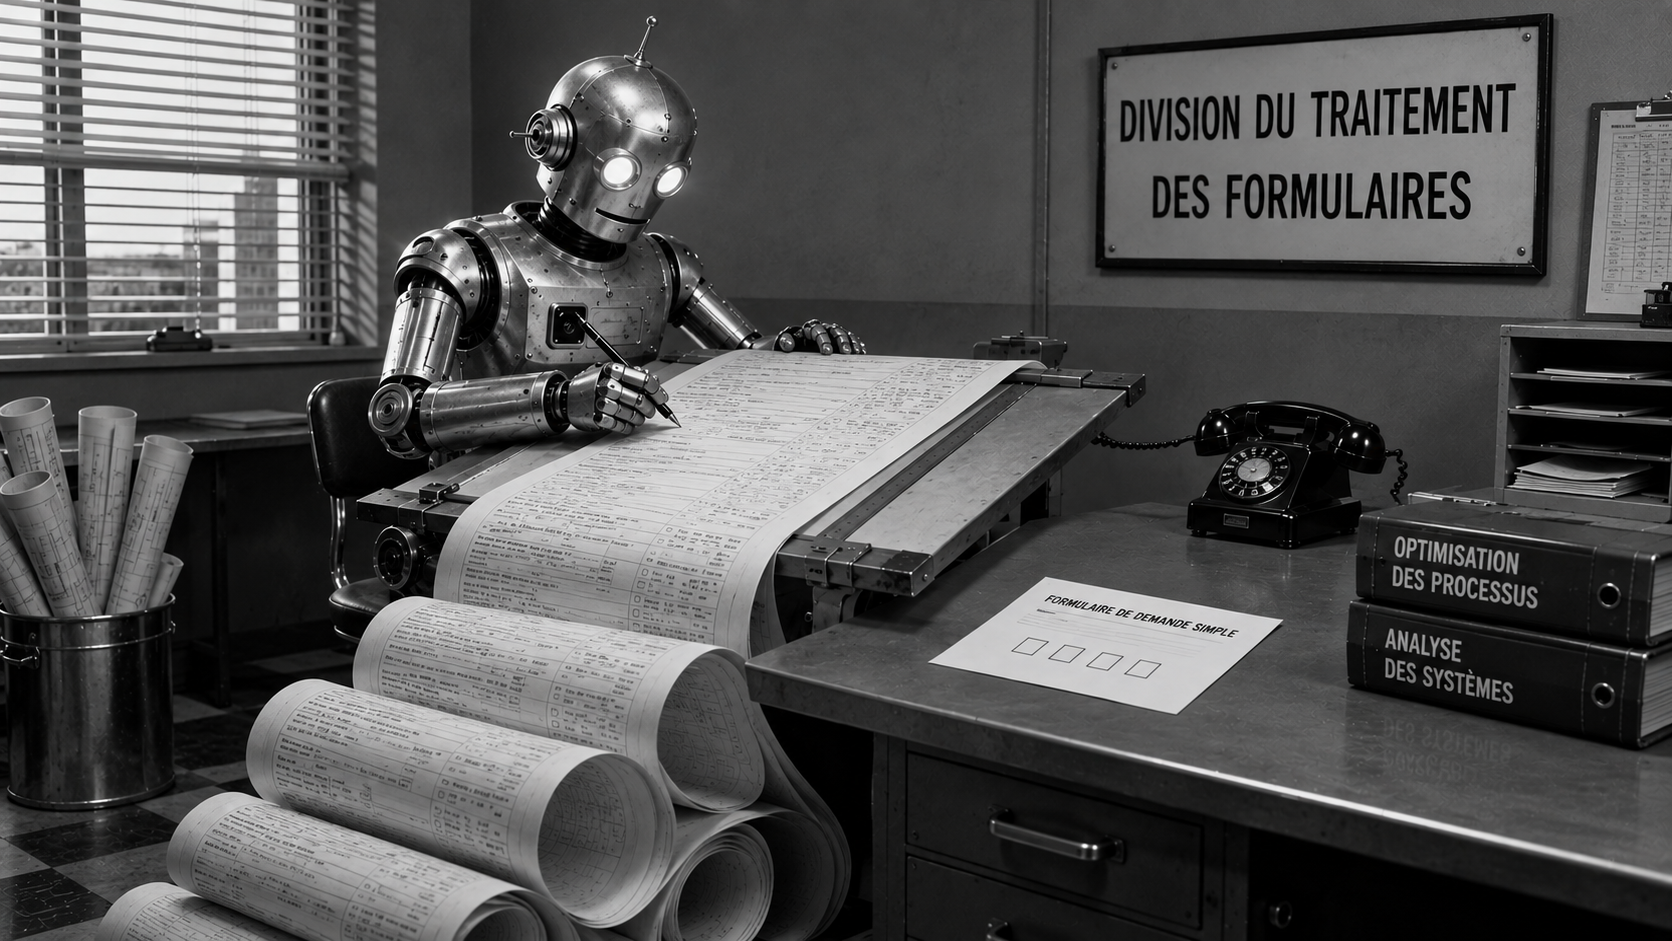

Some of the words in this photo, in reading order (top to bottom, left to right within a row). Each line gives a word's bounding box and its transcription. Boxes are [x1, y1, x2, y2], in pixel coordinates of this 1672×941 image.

[1120, 95, 1241, 142] DIVISION
[1255, 92, 1296, 139] DU
[1311, 83, 1516, 137] TRAITEMENT
[1153, 174, 1210, 218] DES
[1226, 171, 1472, 220] FORMULAIRES
[1394, 535, 1520, 575] OPTIMISATION
[1392, 565, 1425, 590] DES
[1432, 574, 1538, 609] PROCESSUS
[1044, 594, 1115, 615] FORMULAIRE
[1115, 607, 1134, 619] DE
[1134, 611, 1192, 630] DEMANDE
[1192, 622, 1239, 638] SIMPLE
[1385, 628, 1462, 663] ANALYSE
[1384, 658, 1417, 684] DES
[1422, 665, 1514, 704] SYSTÈMES
